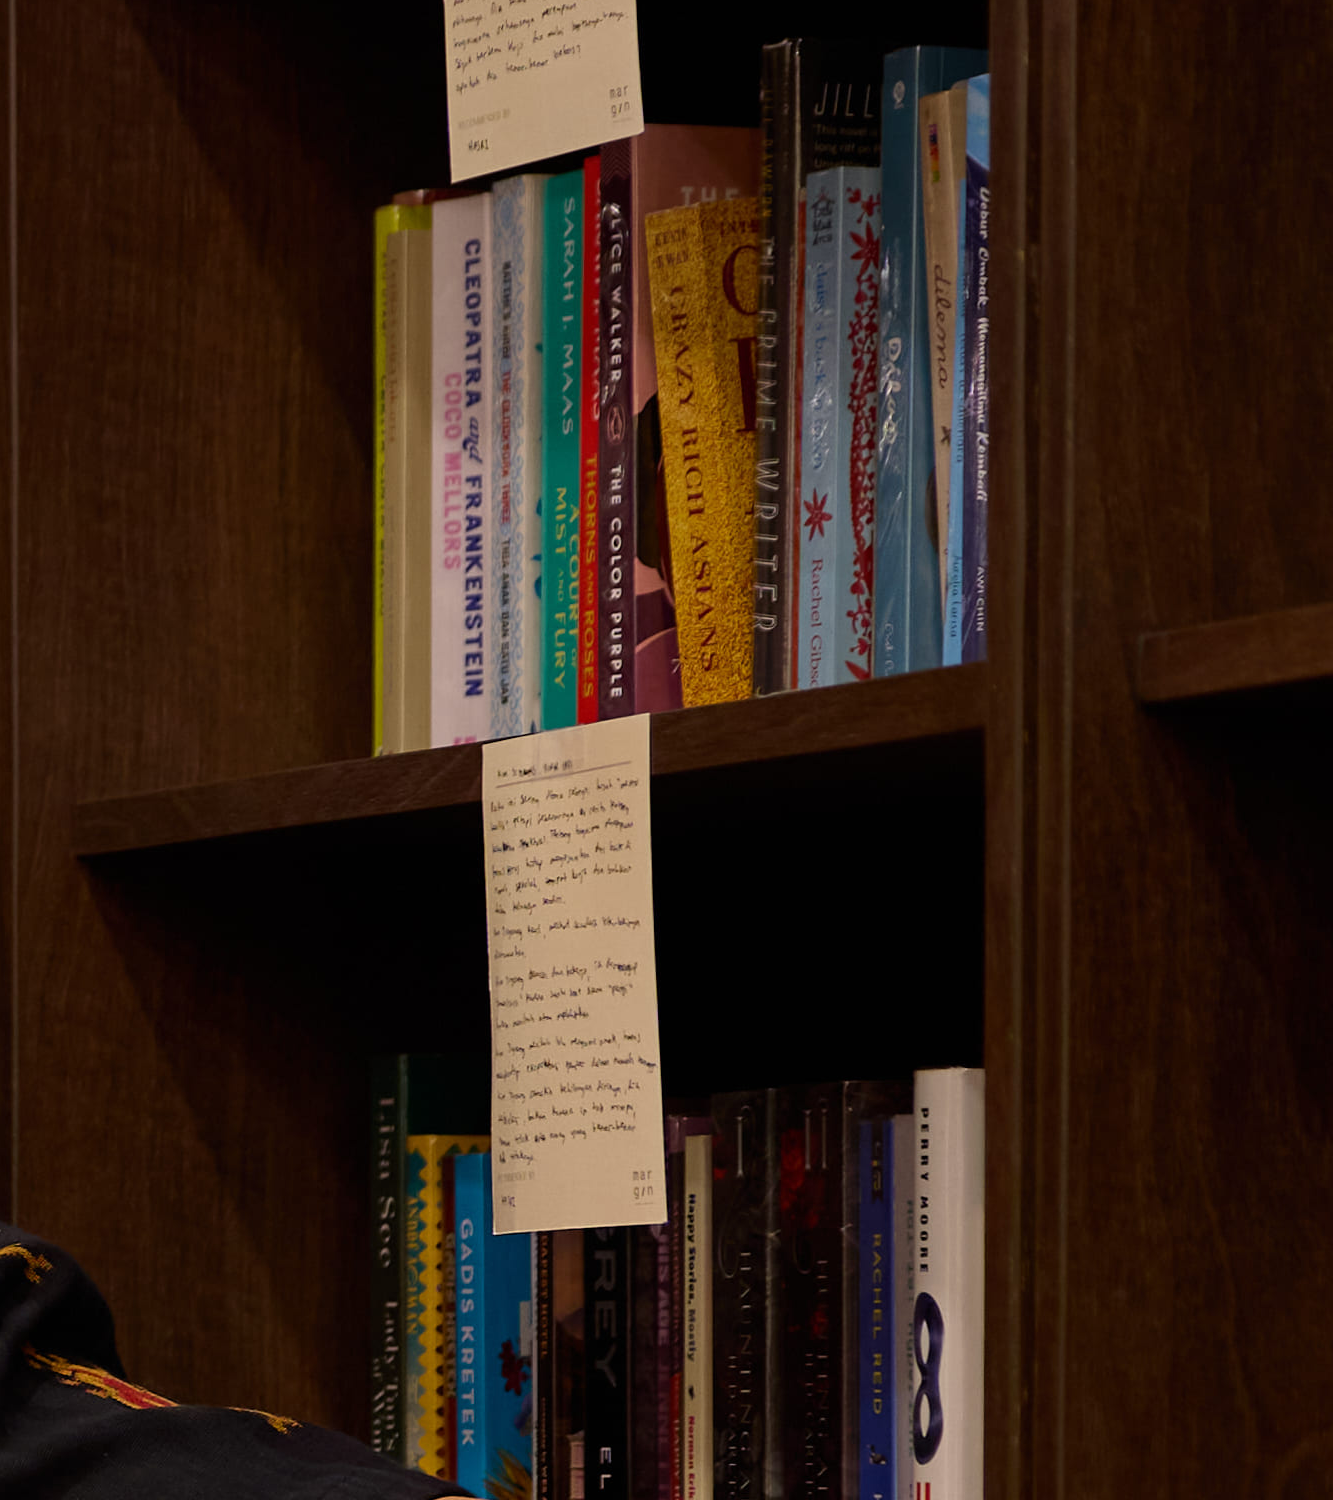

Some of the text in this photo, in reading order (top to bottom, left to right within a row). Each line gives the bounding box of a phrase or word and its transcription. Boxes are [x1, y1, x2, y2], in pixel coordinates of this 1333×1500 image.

[443, 372, 462, 570] COCO MELLORS
[462, 240, 485, 697] CLEOPATRA and FRANKENSTEIN
[608, 464, 624, 698] THE COLOR PURPLE
[668, 286, 719, 673] CRAZY RICH ASIANS
[460, 1218, 476, 1446] GADIS KRETEK
